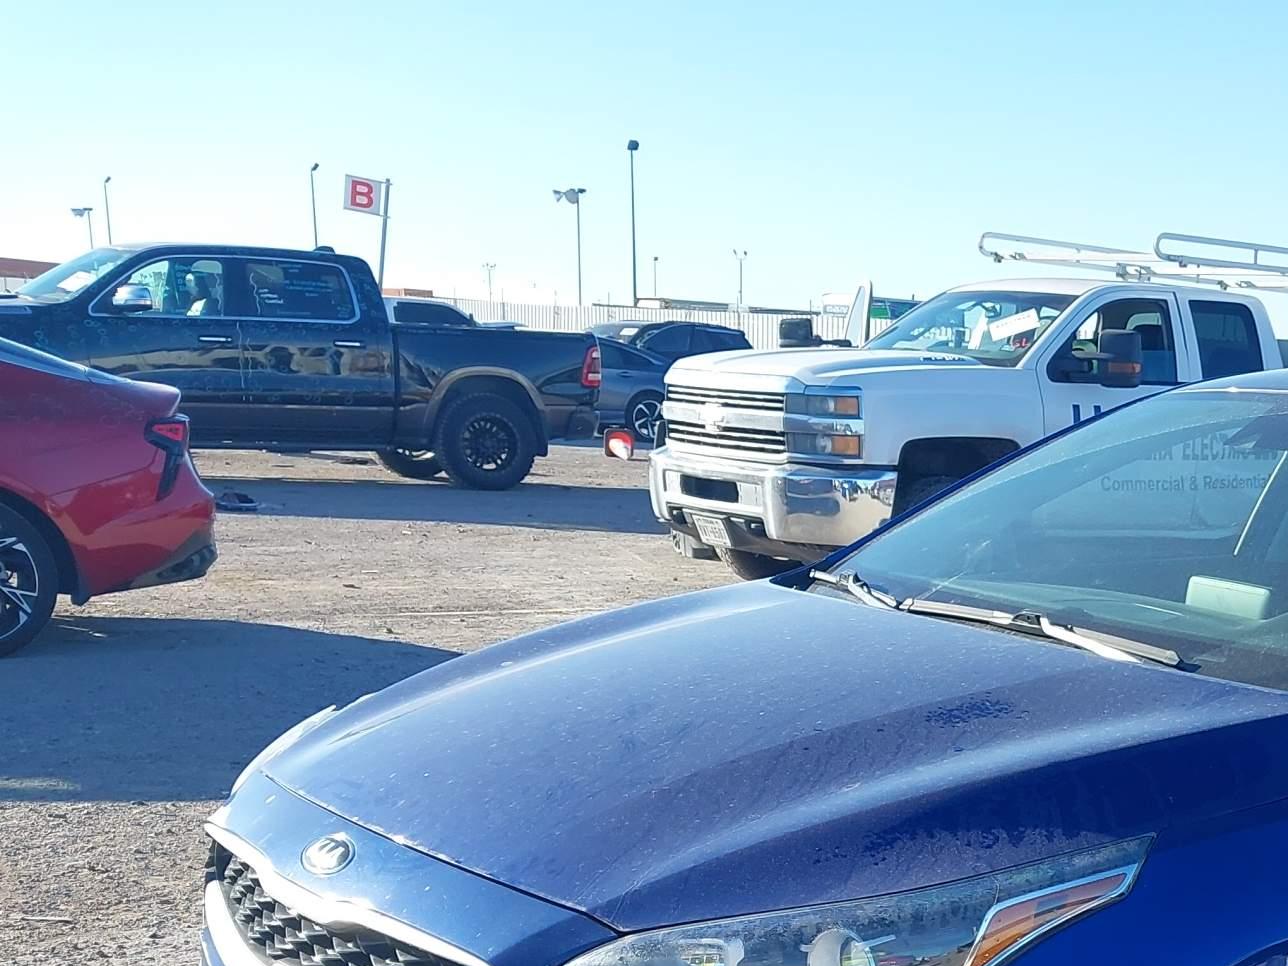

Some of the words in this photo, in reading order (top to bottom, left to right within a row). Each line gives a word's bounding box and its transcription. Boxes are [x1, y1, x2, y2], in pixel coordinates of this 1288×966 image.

[351, 179, 374, 209] B
[1101, 475, 1184, 492] Commercial
[1189, 475, 1199, 491] &
